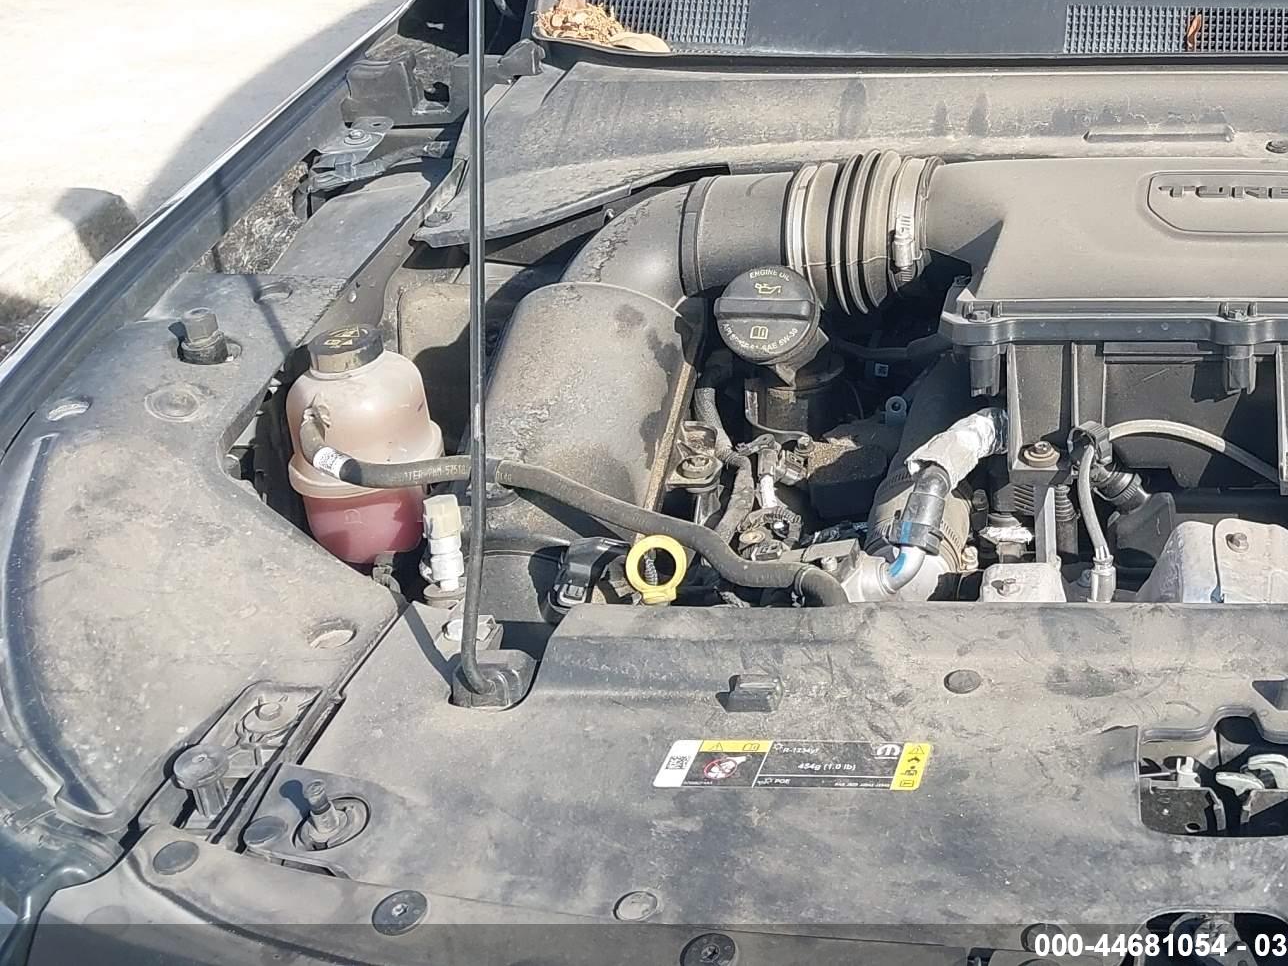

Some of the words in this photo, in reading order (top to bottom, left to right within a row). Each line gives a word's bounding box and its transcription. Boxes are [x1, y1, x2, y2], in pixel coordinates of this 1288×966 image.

[749, 269, 778, 279] ENGINE
[779, 272, 790, 282] OIL
[782, 746, 820, 755] R-1234yf
[797, 762, 822, 771] 454g
[823, 763, 842, 771] (1.0
[843, 763, 856, 771] lb)
